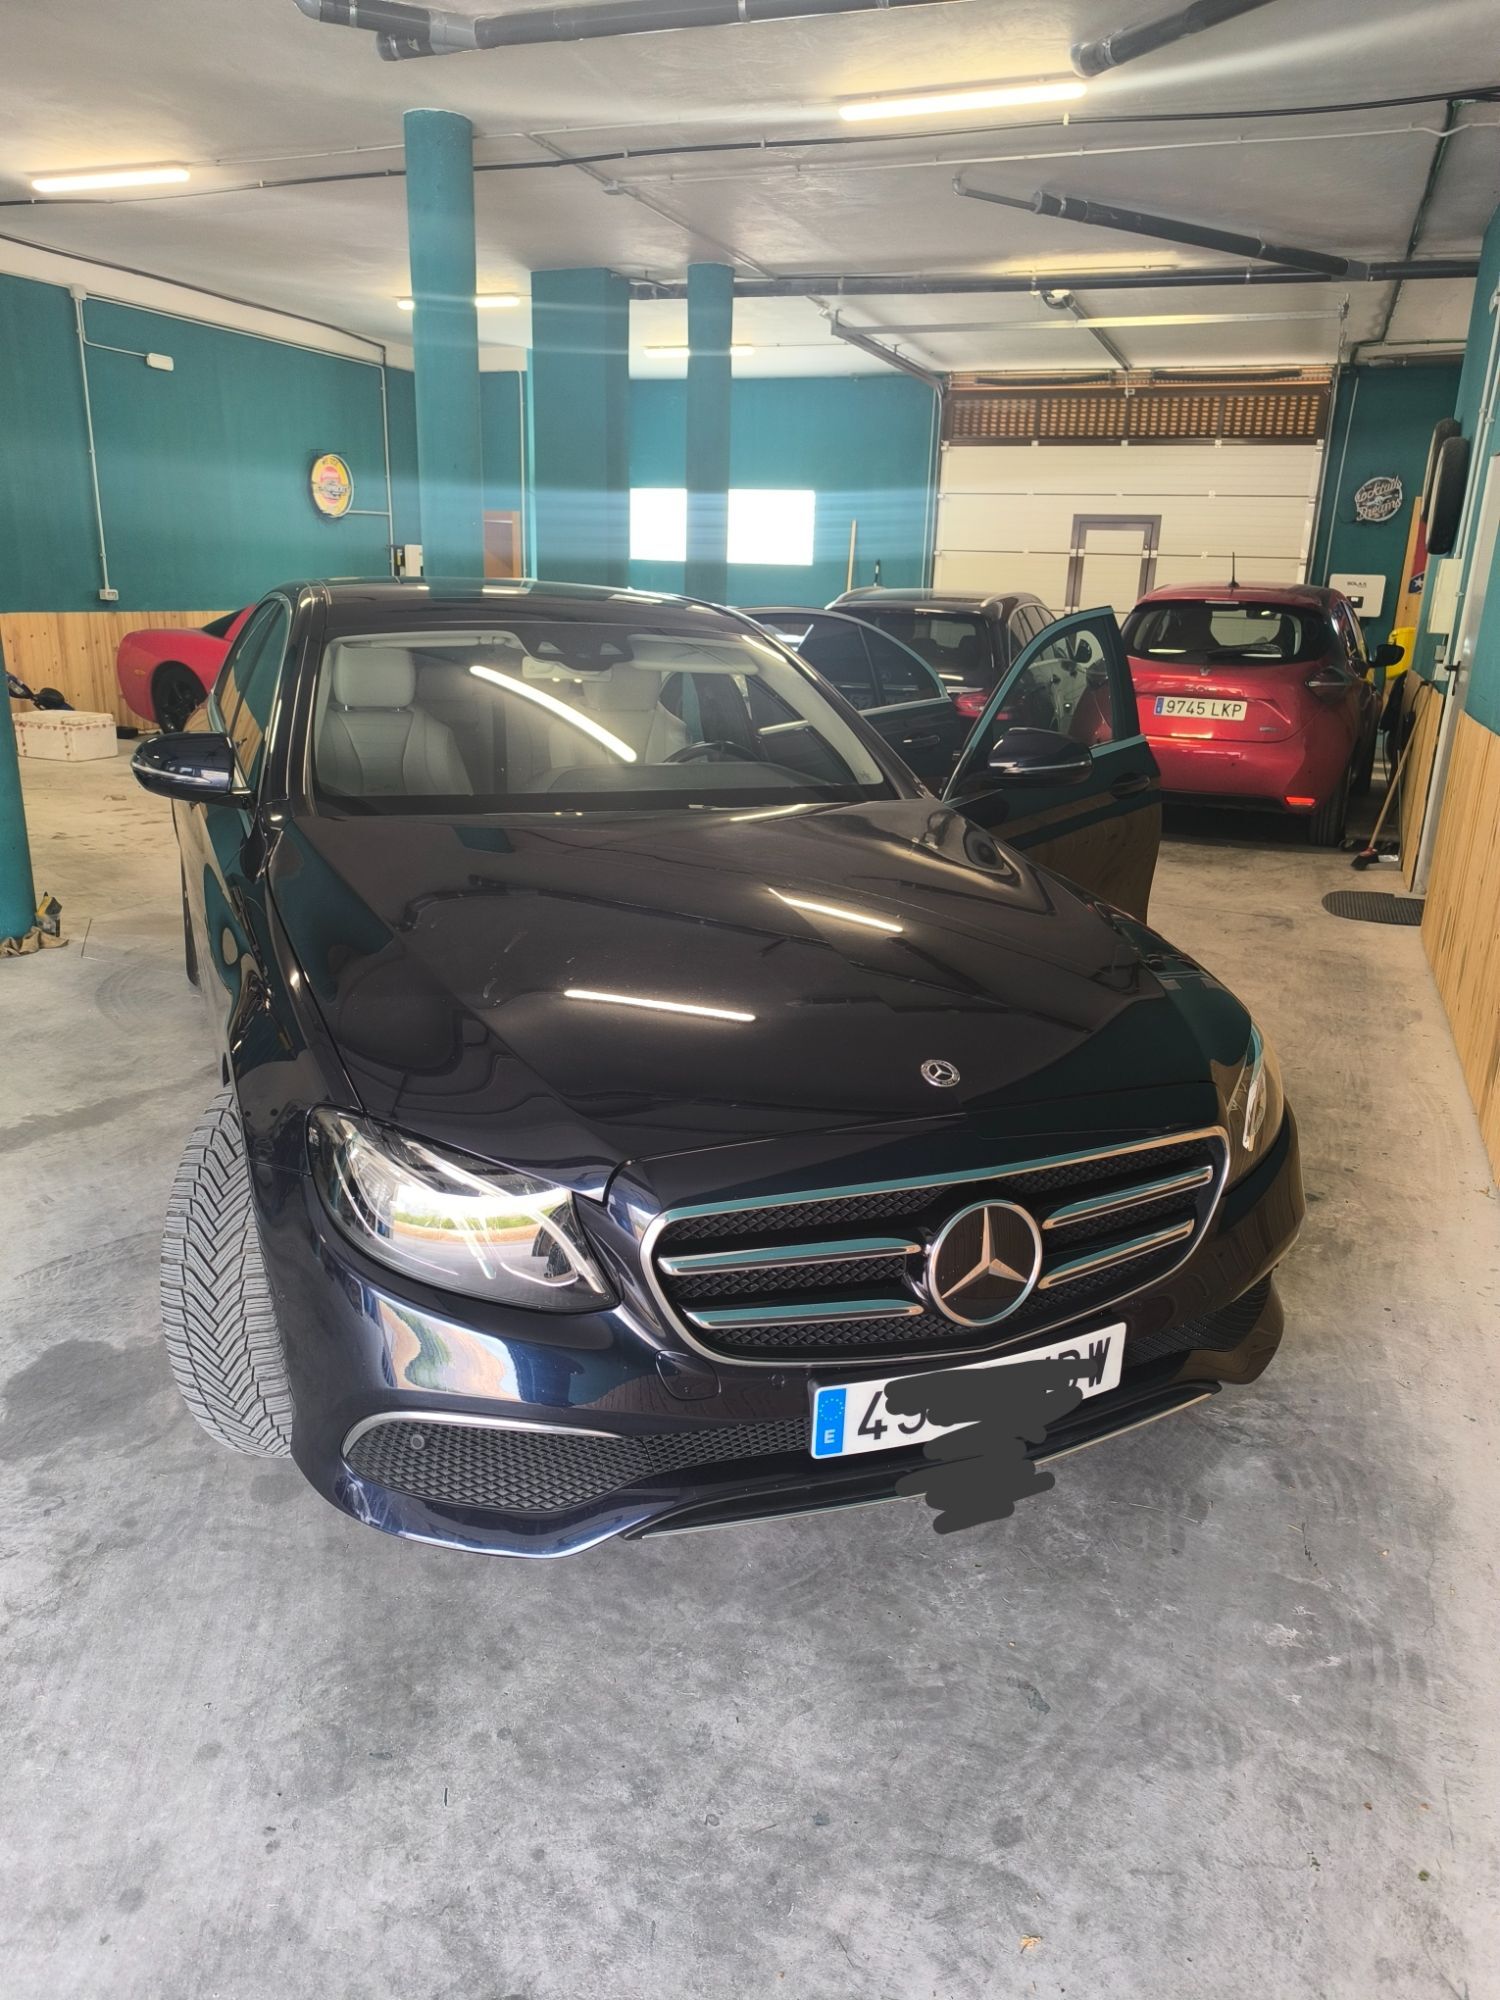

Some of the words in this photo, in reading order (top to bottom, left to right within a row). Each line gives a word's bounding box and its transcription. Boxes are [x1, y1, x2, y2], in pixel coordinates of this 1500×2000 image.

[1355, 475, 1402, 502] Cocktails
[1356, 498, 1402, 521] Dreams
[1166, 700, 1206, 715] 9745
[1211, 702, 1242, 718] LKP
[824, 1429, 836, 1444] E
